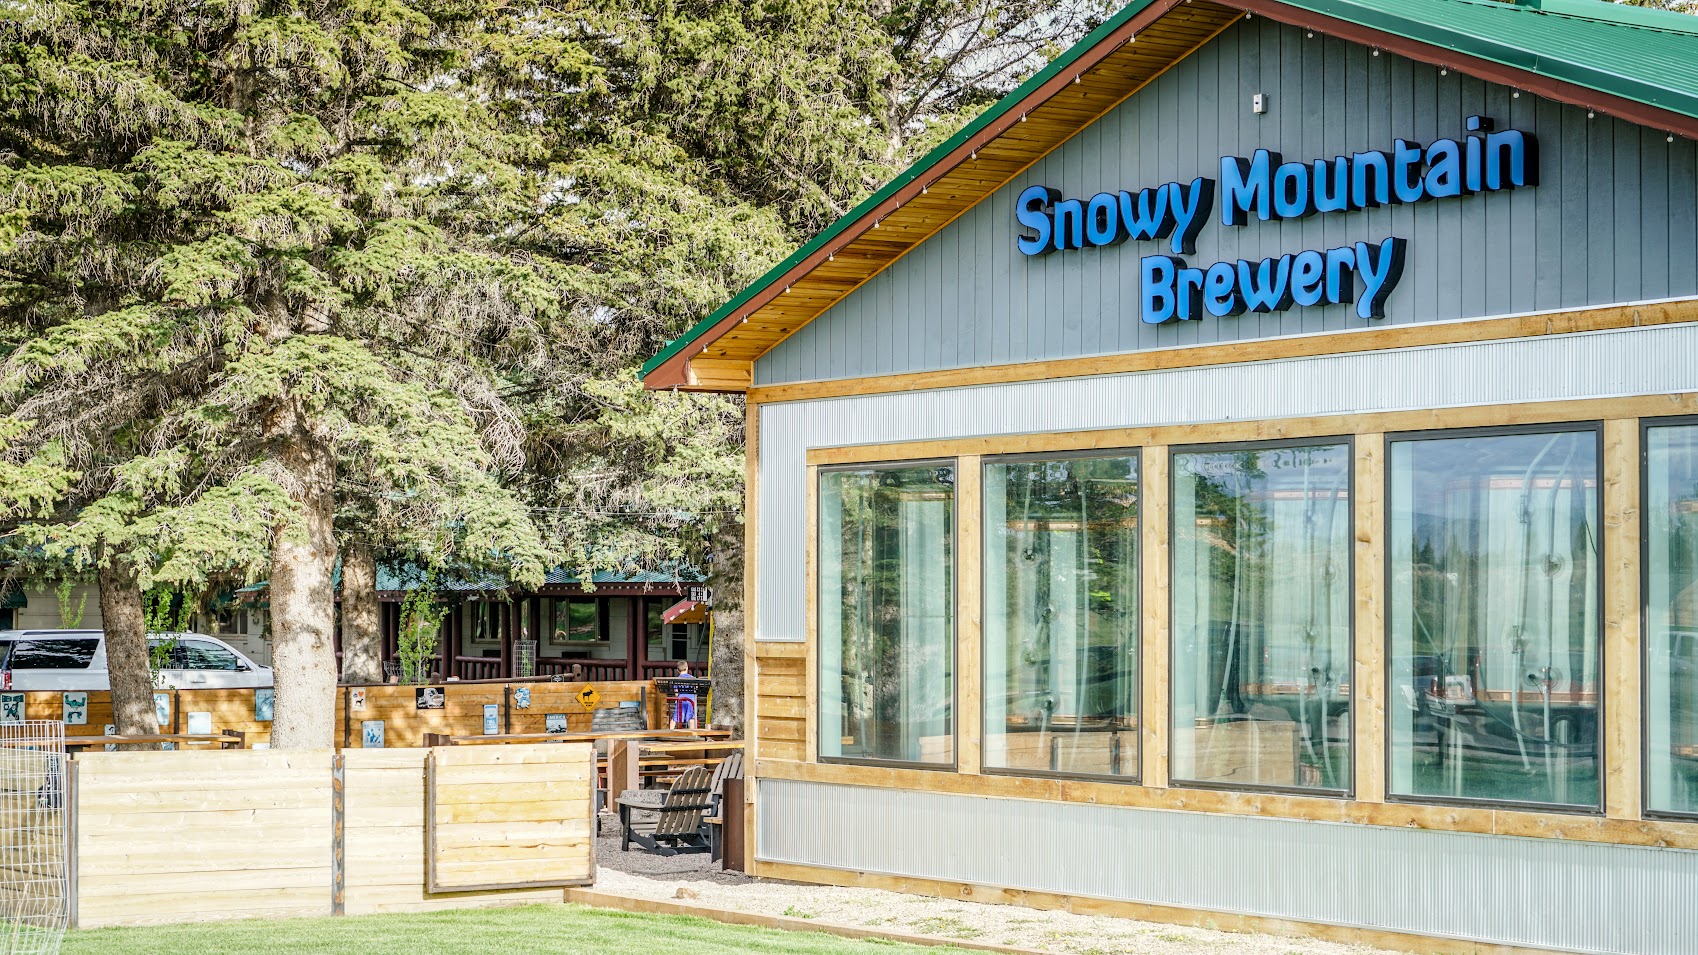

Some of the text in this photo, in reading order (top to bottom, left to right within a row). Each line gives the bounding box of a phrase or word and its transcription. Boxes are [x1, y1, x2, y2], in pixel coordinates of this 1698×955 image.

[1016, 115, 1537, 256] Snowy Mountain
[1141, 237, 1405, 325] Brewery
